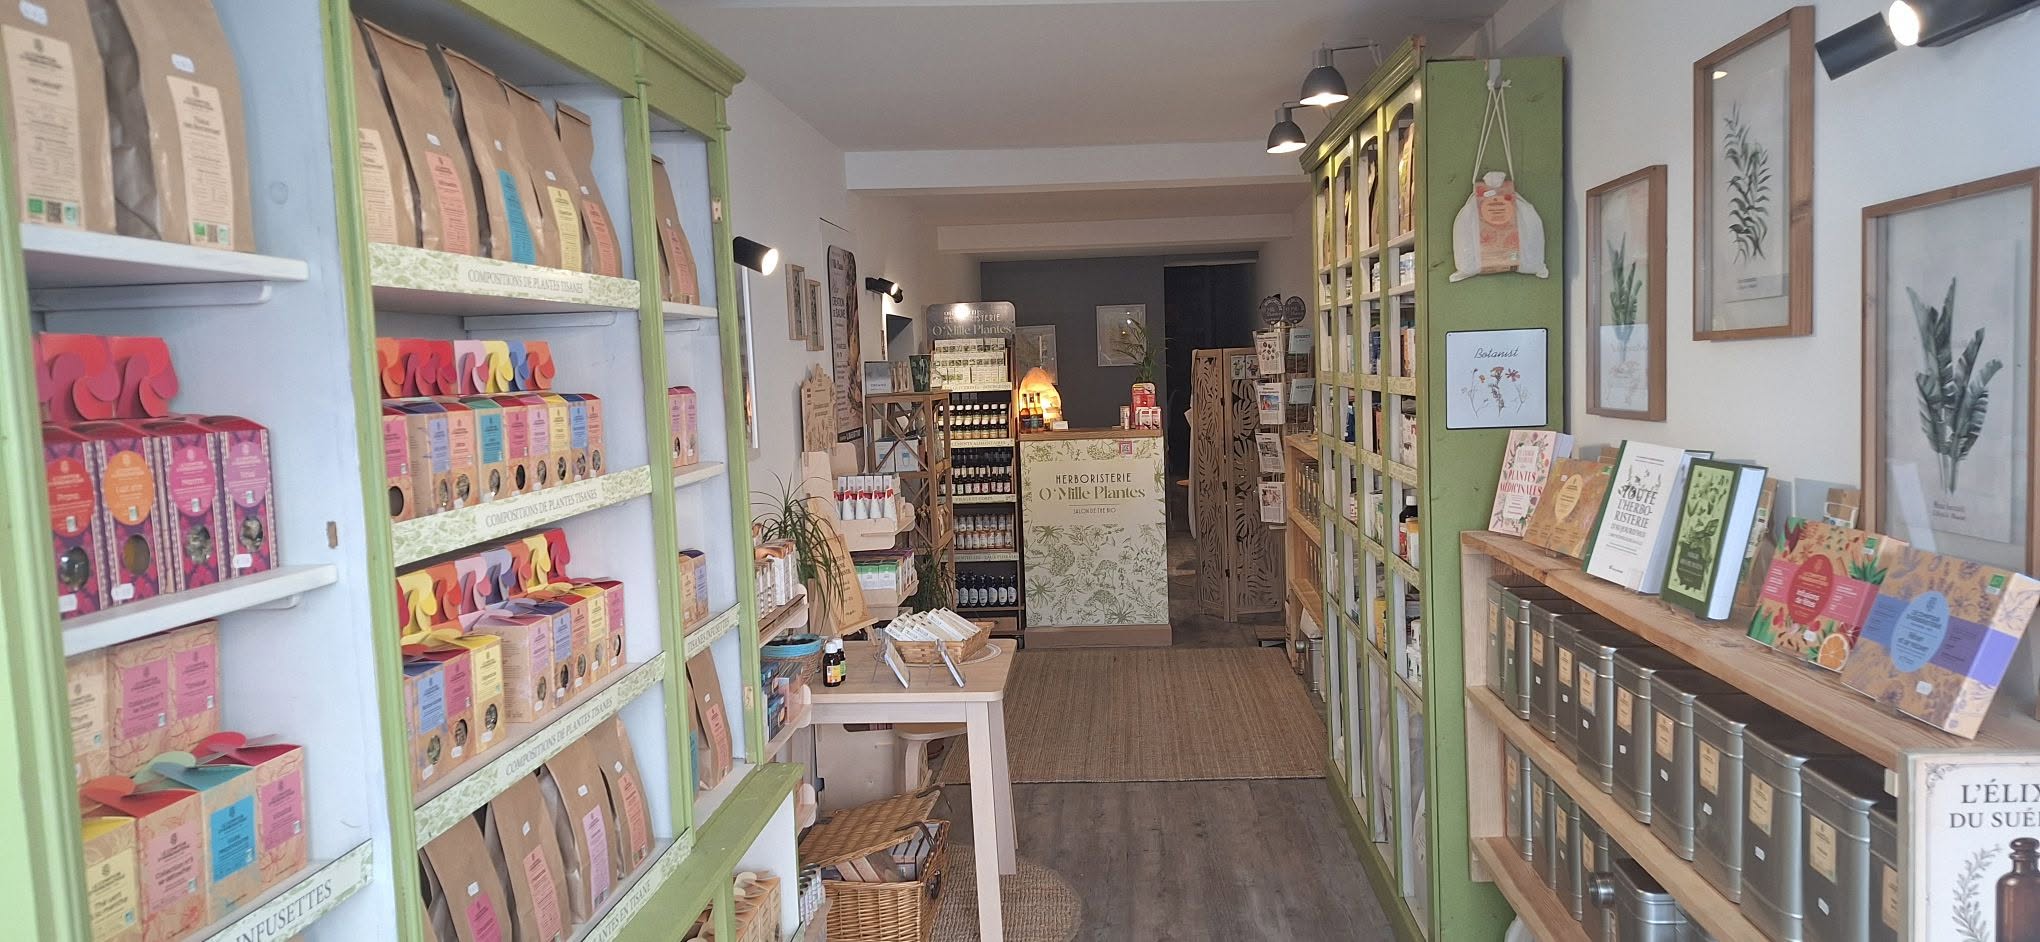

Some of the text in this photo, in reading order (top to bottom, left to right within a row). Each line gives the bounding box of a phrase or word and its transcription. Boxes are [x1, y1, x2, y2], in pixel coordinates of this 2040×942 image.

[468, 269, 521, 288] COMPOSITIONS
[532, 276, 560, 291] PLANTES
[973, 323, 1012, 335] Plantes
[1473, 346, 1520, 359] Botanist
[1055, 472, 1132, 484] HERBORISTERIE
[1507, 469, 1538, 482] PLANTES
[1094, 485, 1146, 499] Plantes
[1500, 481, 1543, 497] MÉDICINALES
[1620, 484, 1659, 505] TOUTE
[485, 503, 539, 528] COMPOSITIONS
[548, 495, 575, 512] PLANTES
[1073, 507, 1089, 515] SALON
[1617, 499, 1653, 516] L'HERBO-
[1613, 510, 1650, 529] RISTERIE
[505, 735, 557, 776] COMPOSITIONS
[565, 711, 591, 736] PLANTES
[1949, 808, 2040, 828] DU SUÉ
[236, 879, 332, 942] NFUSETTES
